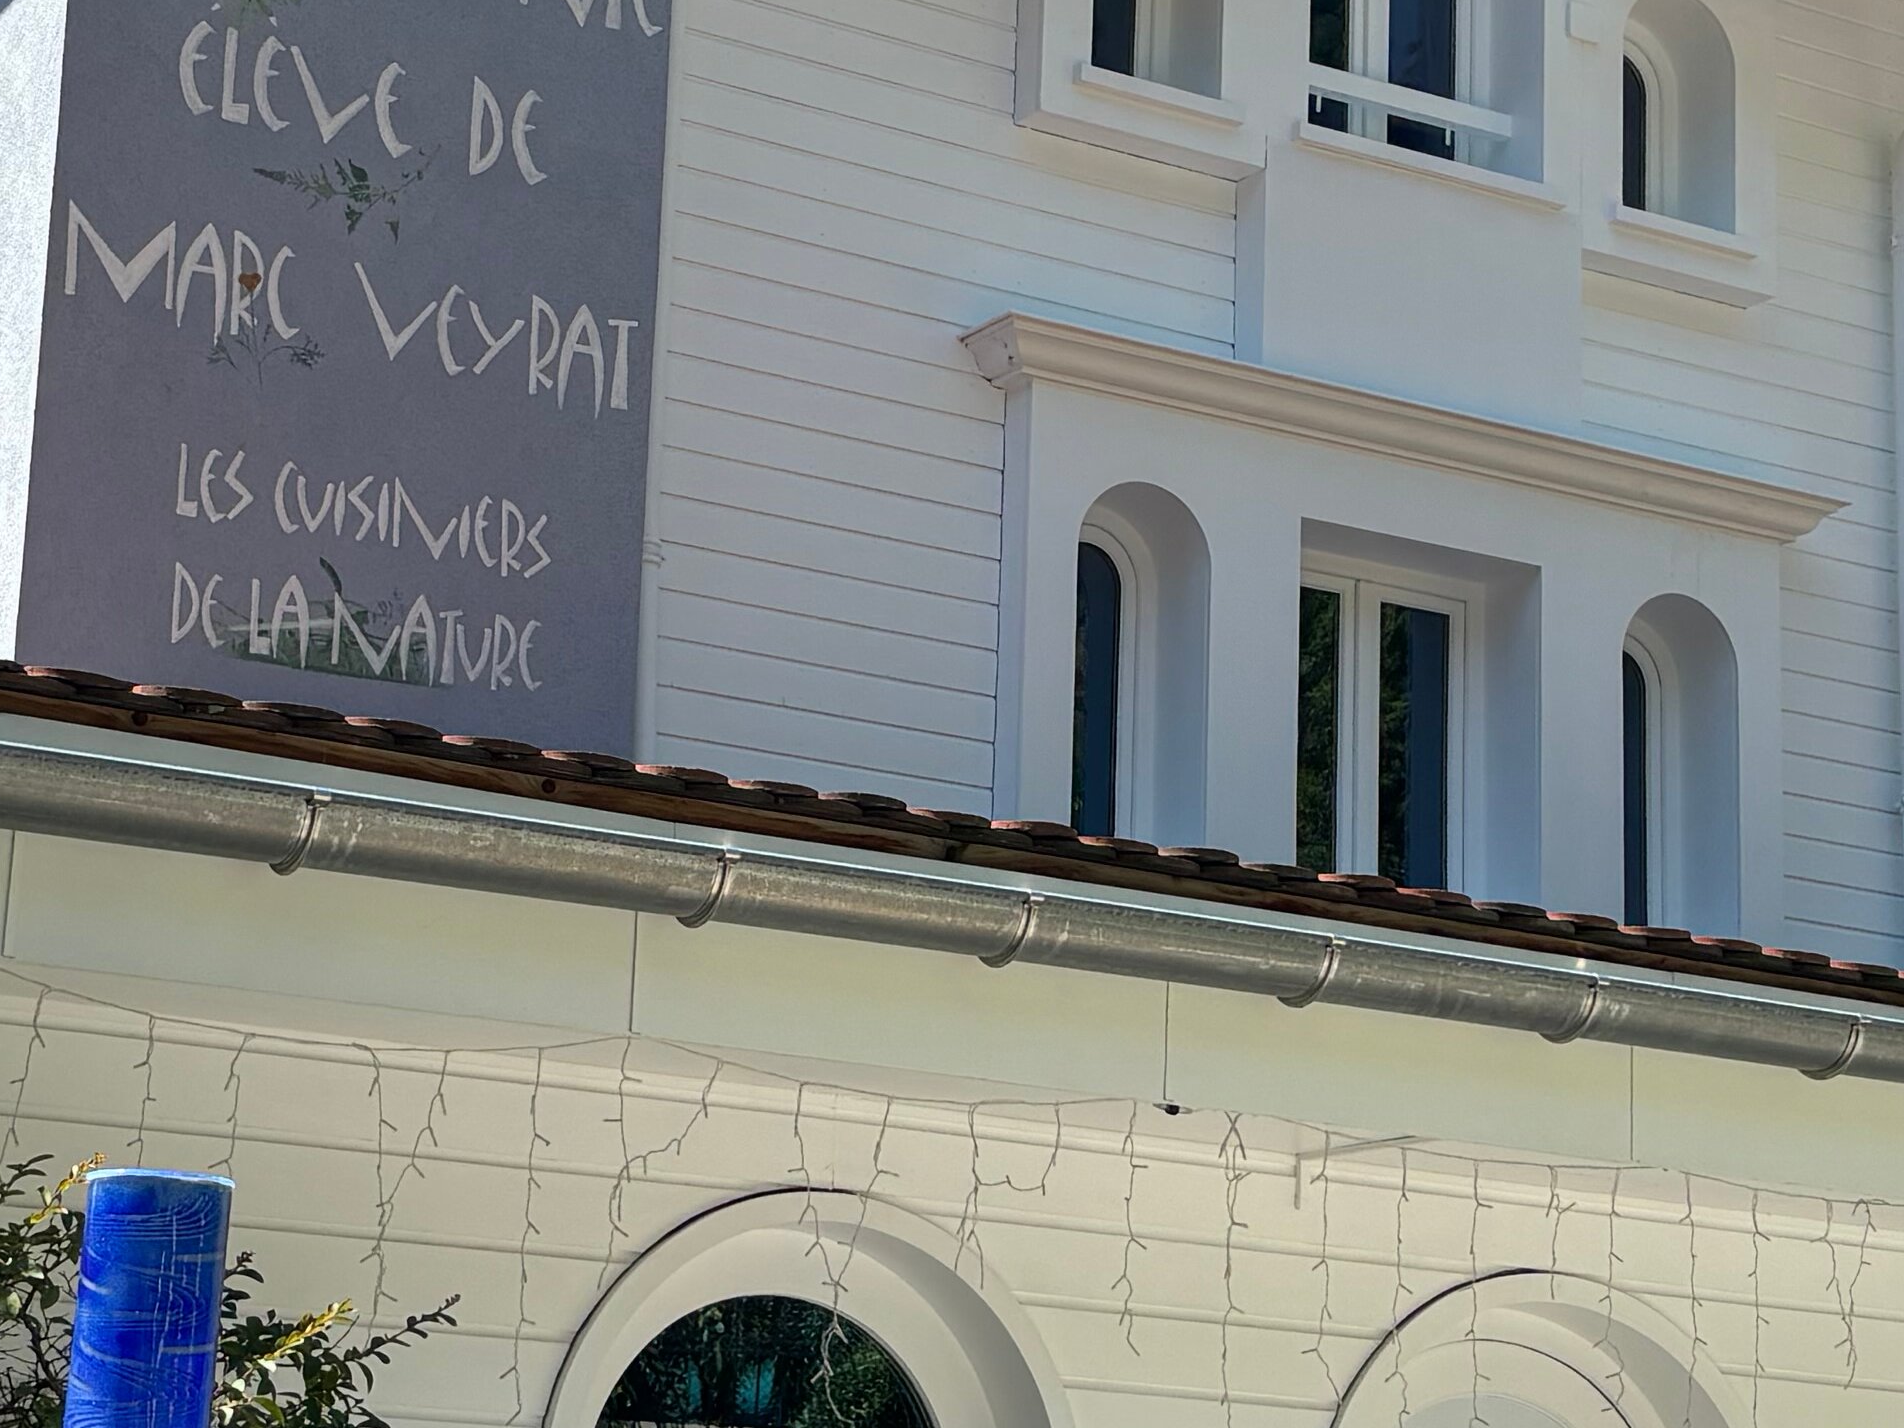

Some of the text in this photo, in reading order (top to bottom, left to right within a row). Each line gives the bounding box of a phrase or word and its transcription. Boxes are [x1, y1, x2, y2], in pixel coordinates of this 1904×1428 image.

[179, 2, 548, 184] ÉLÈVE DE
[64, 200, 638, 420] MARC VEYRAT
[176, 442, 552, 580] LES CUISINIERS
[170, 560, 543, 692] DE LA NATURE
